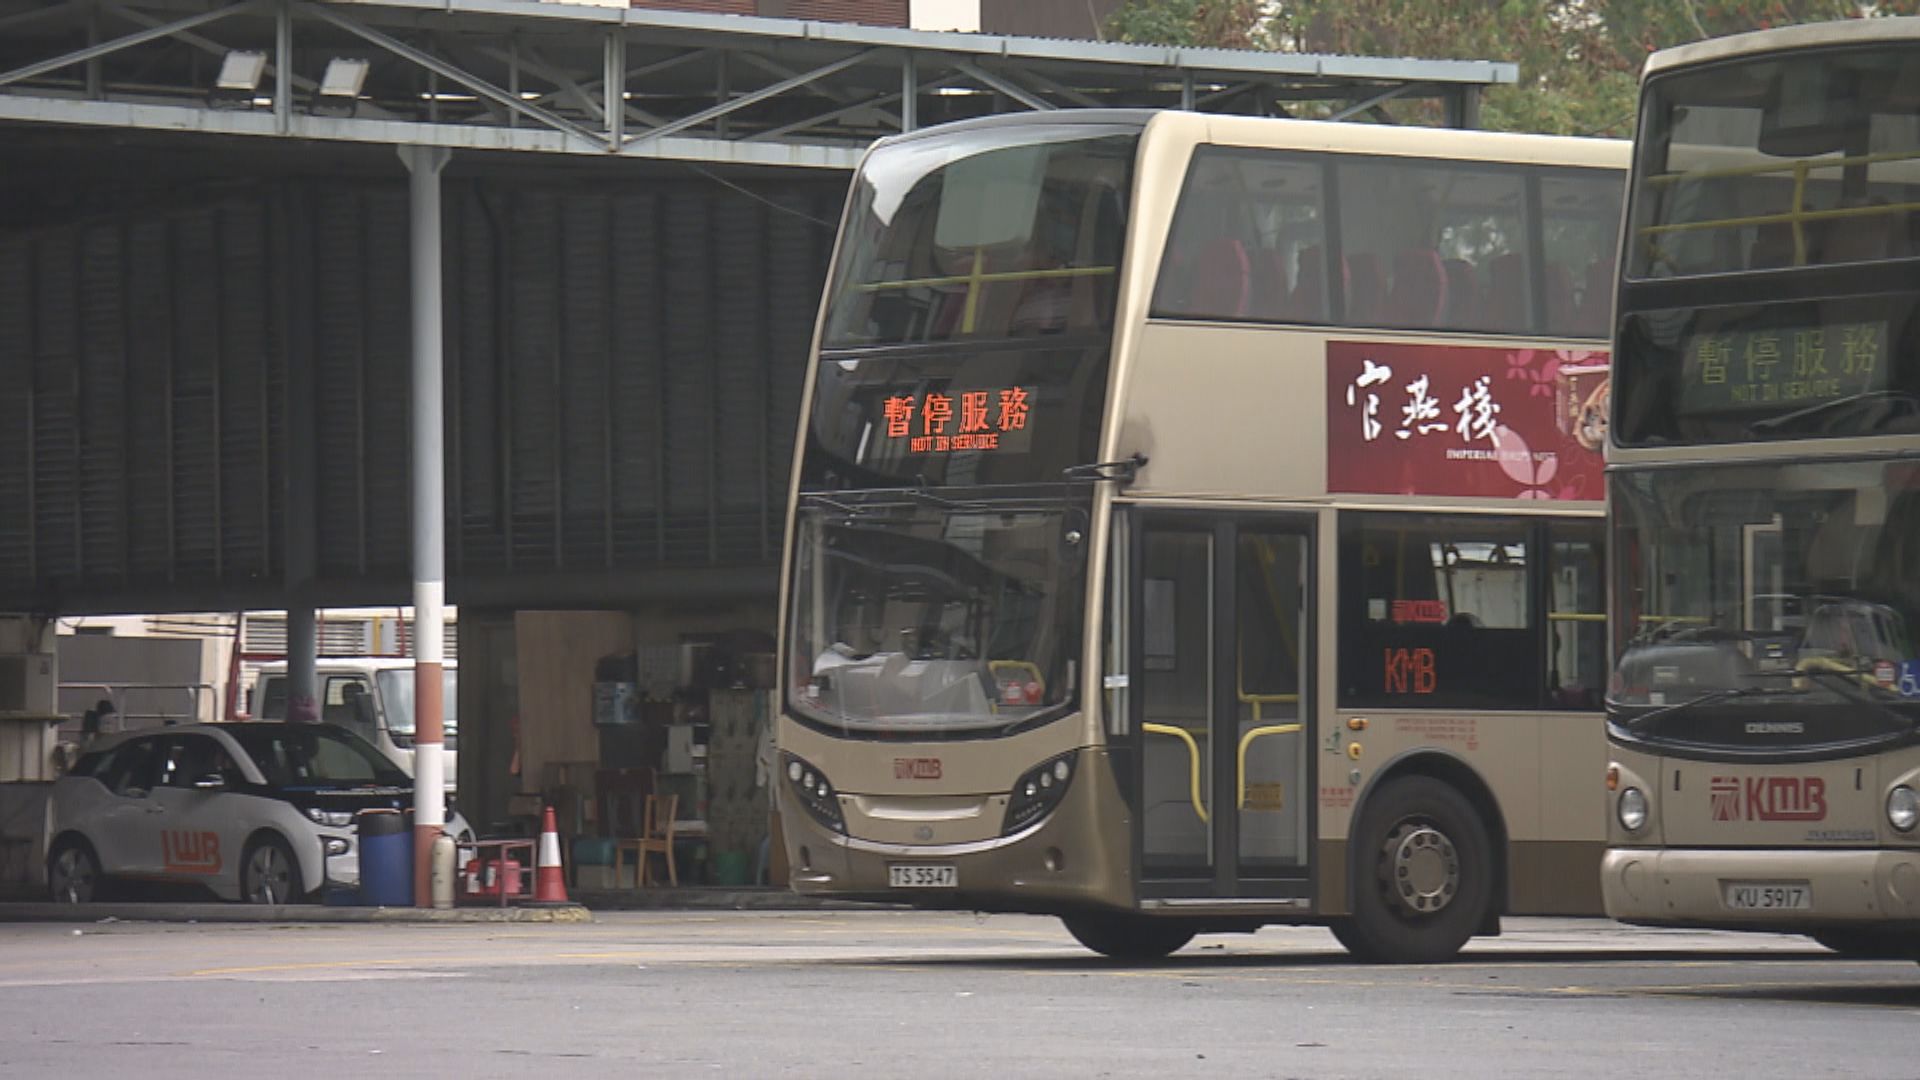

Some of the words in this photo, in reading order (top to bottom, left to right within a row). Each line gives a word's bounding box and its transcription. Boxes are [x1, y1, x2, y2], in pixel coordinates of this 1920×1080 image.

[1699, 325, 1879, 385] 暫停服務
[884, 386, 1029, 438] 暫停服務
[1346, 359, 1501, 448] 官燕棧
[911, 436, 932, 452] NOT
[935, 436, 950, 452] IN
[951, 434, 998, 449] SERVICE
[1384, 647, 1437, 694] KMB
[1745, 722, 1803, 734] DENNIS
[905, 758, 942, 779] KMB
[1745, 777, 1827, 821] KMB
[894, 867, 912, 884] TS
[916, 867, 953, 884] 5547
[1734, 888, 1759, 908] KU
[1763, 888, 1803, 908] 5917
